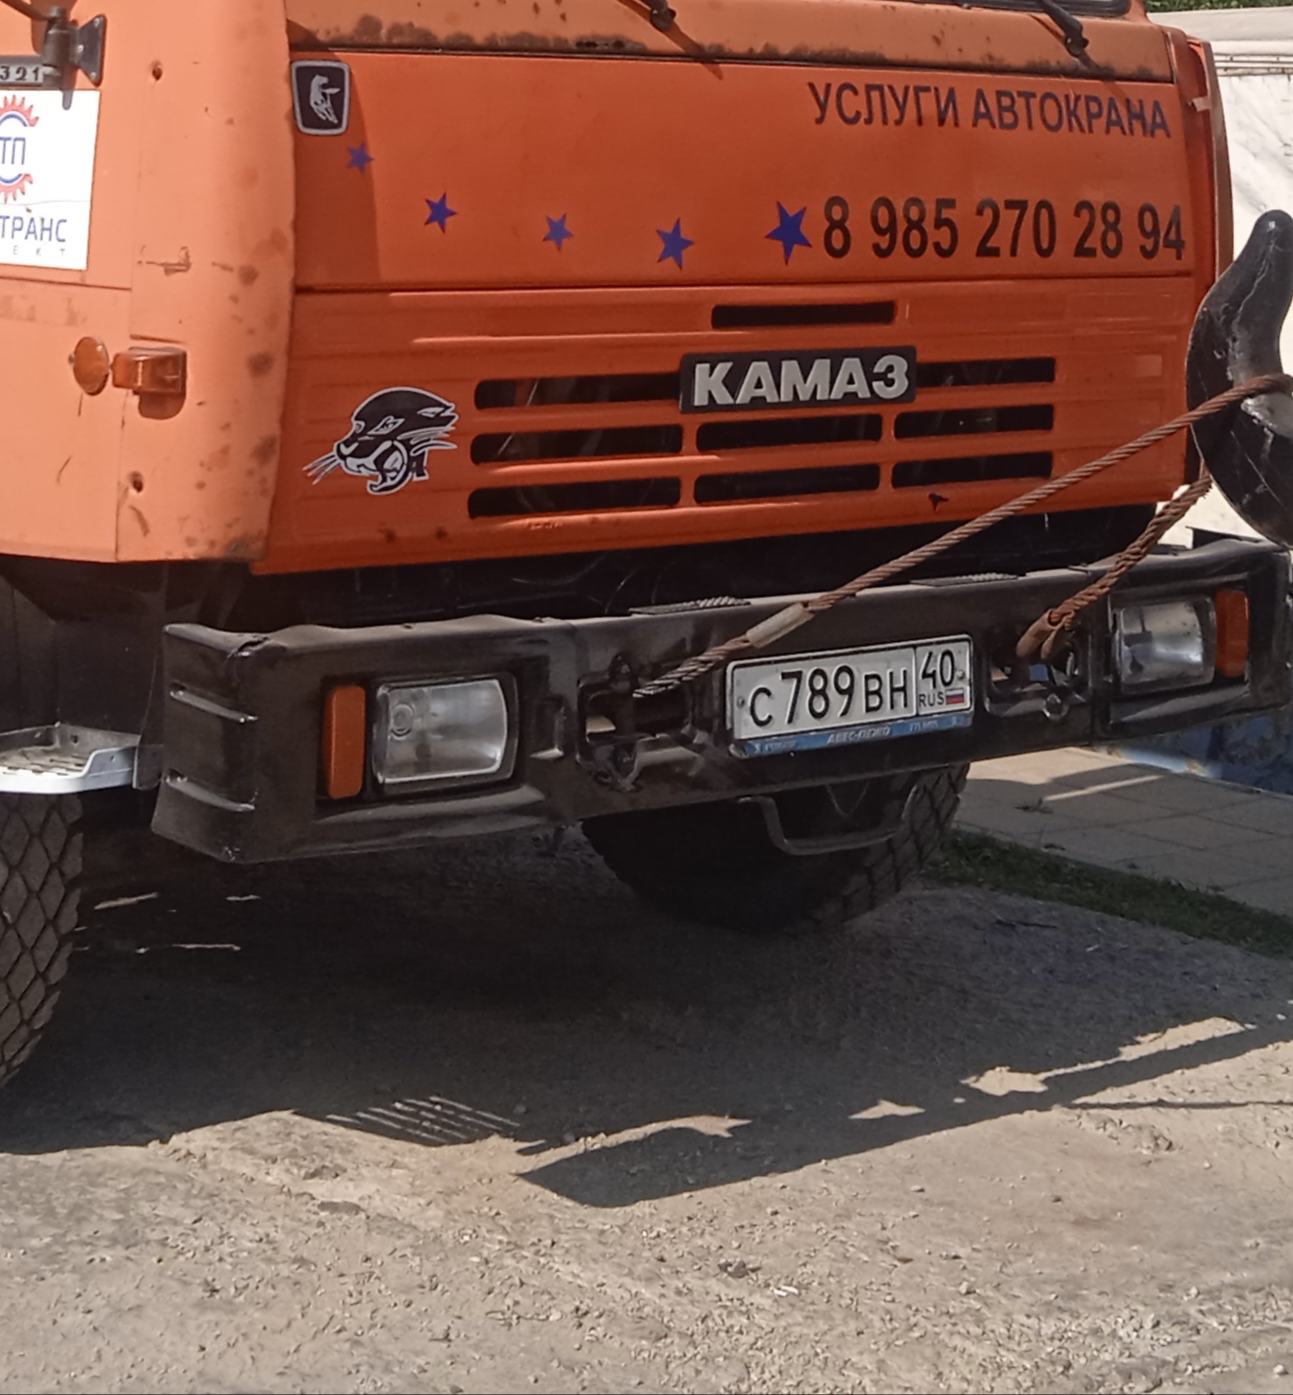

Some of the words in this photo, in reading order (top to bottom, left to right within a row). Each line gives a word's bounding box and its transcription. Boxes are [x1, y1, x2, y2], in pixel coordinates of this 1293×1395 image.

[807, 81, 960, 128] УСЛУГИ
[971, 87, 1172, 139] АВТОКРАНА
[822, 195, 852, 259] 8
[870, 196, 959, 259] 985
[975, 198, 1057, 259] 270
[1072, 199, 1123, 259] 28
[1137, 204, 1186, 261] 94
[693, 354, 909, 407] КАМАЗ
[920, 649, 956, 689] 40
[918, 691, 945, 708] RUS
